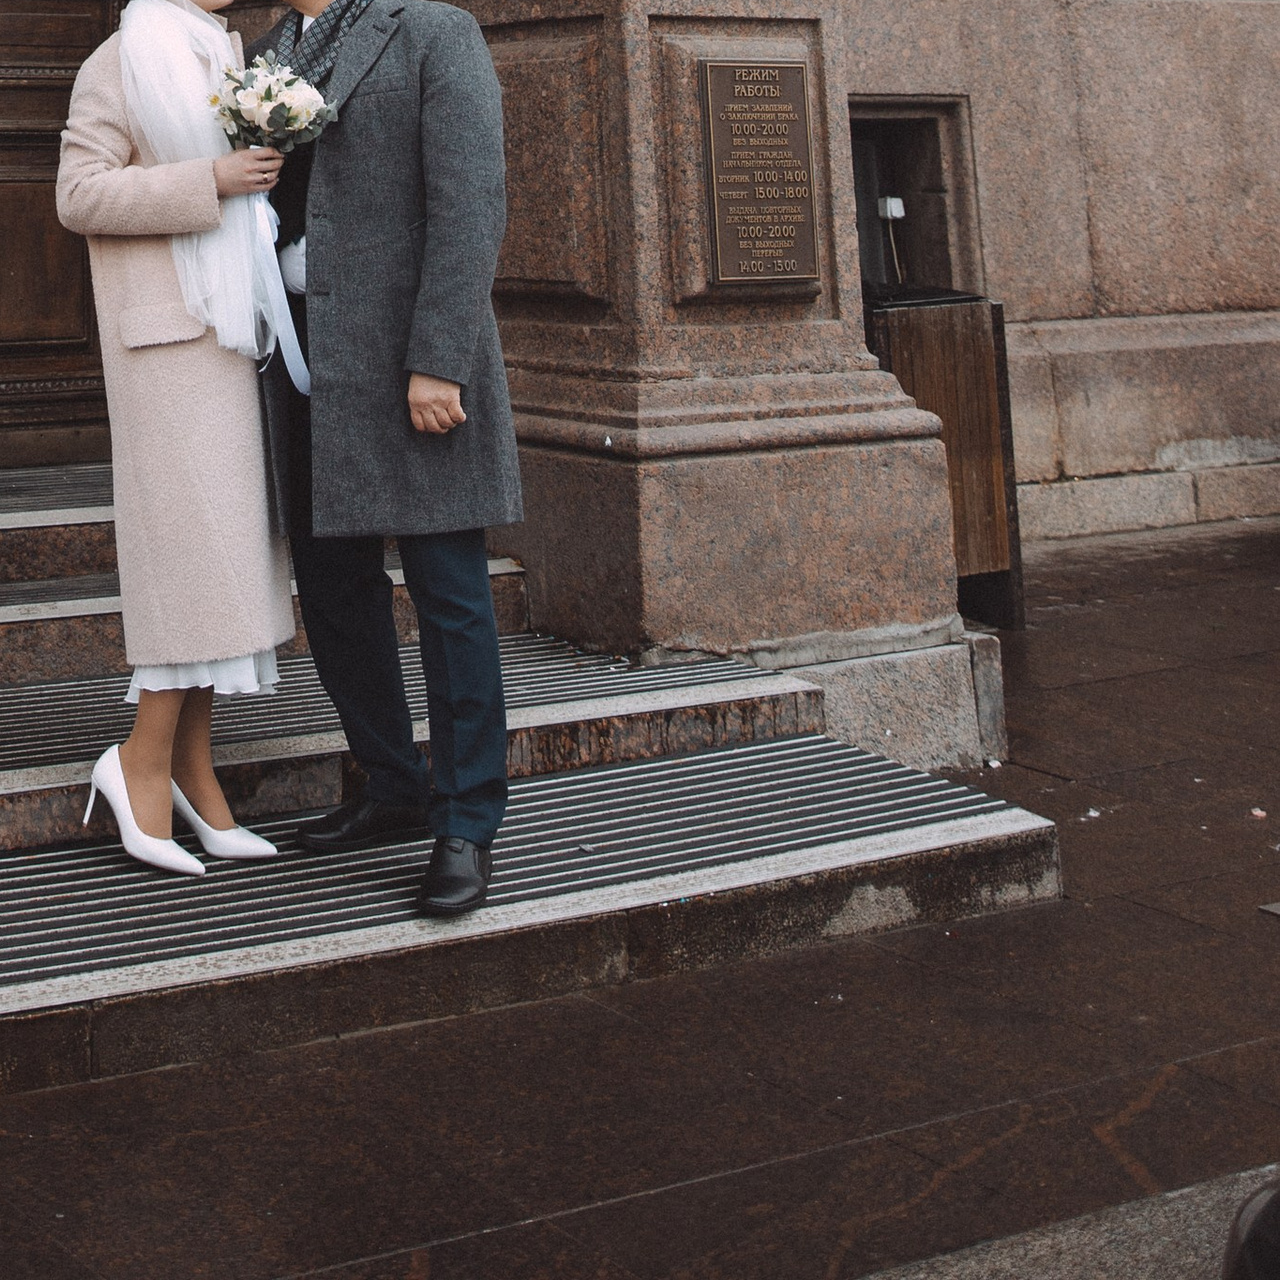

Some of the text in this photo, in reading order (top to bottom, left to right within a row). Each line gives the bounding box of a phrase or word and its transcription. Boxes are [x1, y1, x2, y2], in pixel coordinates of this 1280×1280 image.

[735, 69, 779, 81] РЕЖИМ
[724, 102, 793, 112] ПРИЕМ ЗАЯВЛЕНИЙ
[727, 113, 776, 121] ЗАКЛЮЧЕНИИ
[777, 113, 799, 121] БРАКА
[733, 138, 789, 146] БЕЗ ВЫХОДНЫХ
[730, 151, 793, 160] ПРИЕМ ГРАЖДАН
[723, 160, 802, 168] НАЧАЛЬНИКОМ ОТДЕЛА
[718, 175, 750, 183] ВТОРНИК
[719, 191, 749, 200] ЧЕТВЕРГ
[729, 205, 802, 215] ВЫДАЧА ПОВТОРНЫХ
[725, 215, 772, 224] ДОКУМЕНТОВ
[780, 214, 806, 222] АРХИВЕ
[739, 240, 795, 249] БЕЗ ВЫХОДНЫХ
[751, 249, 784, 258] ПЕРЕРЫВ
